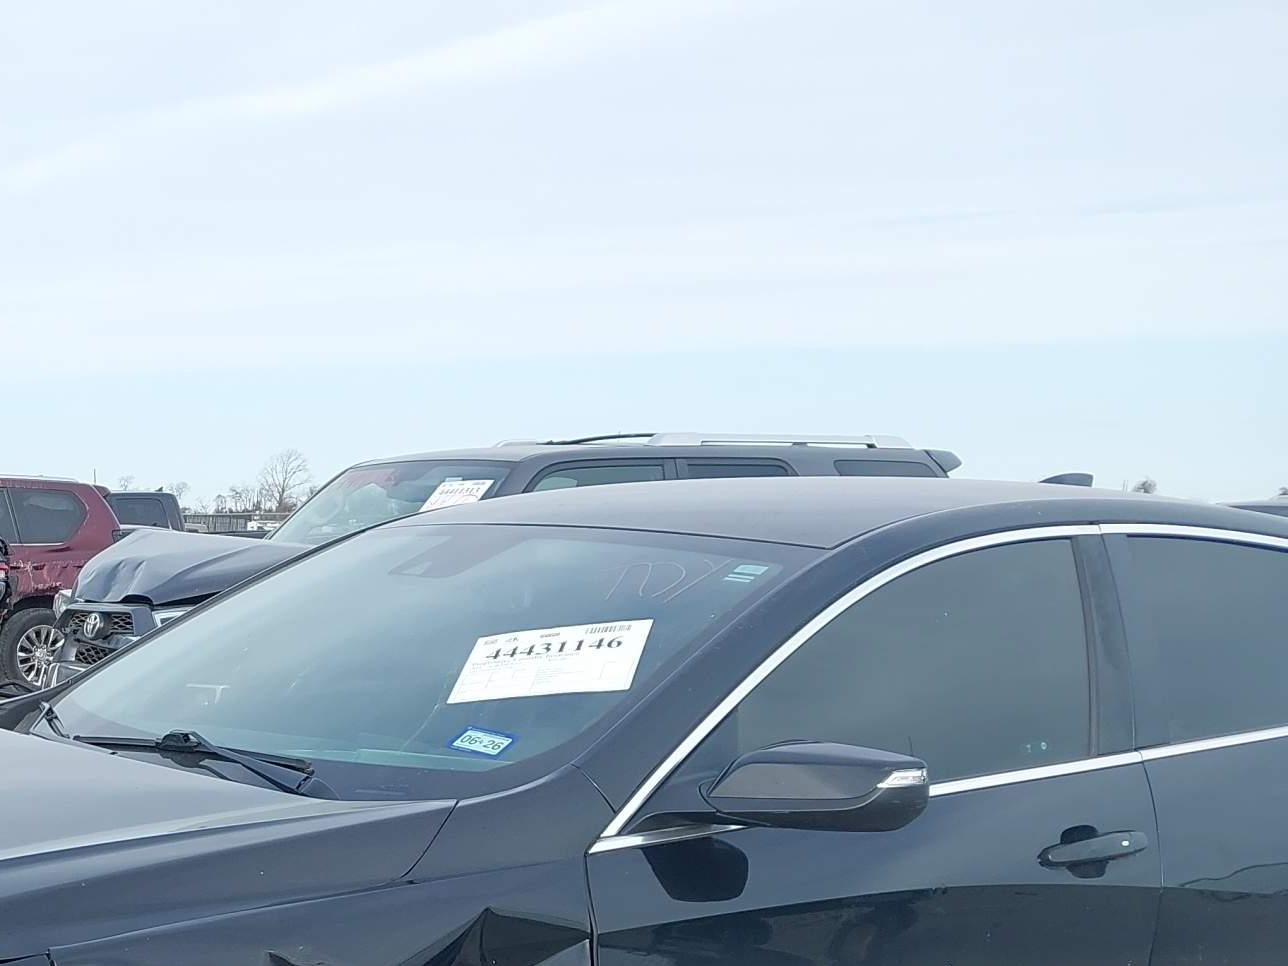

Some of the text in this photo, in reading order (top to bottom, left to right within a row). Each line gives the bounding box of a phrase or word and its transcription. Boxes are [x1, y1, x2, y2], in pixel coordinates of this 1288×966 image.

[486, 636, 624, 660] 44431146
[460, 734, 505, 751] 06 26
